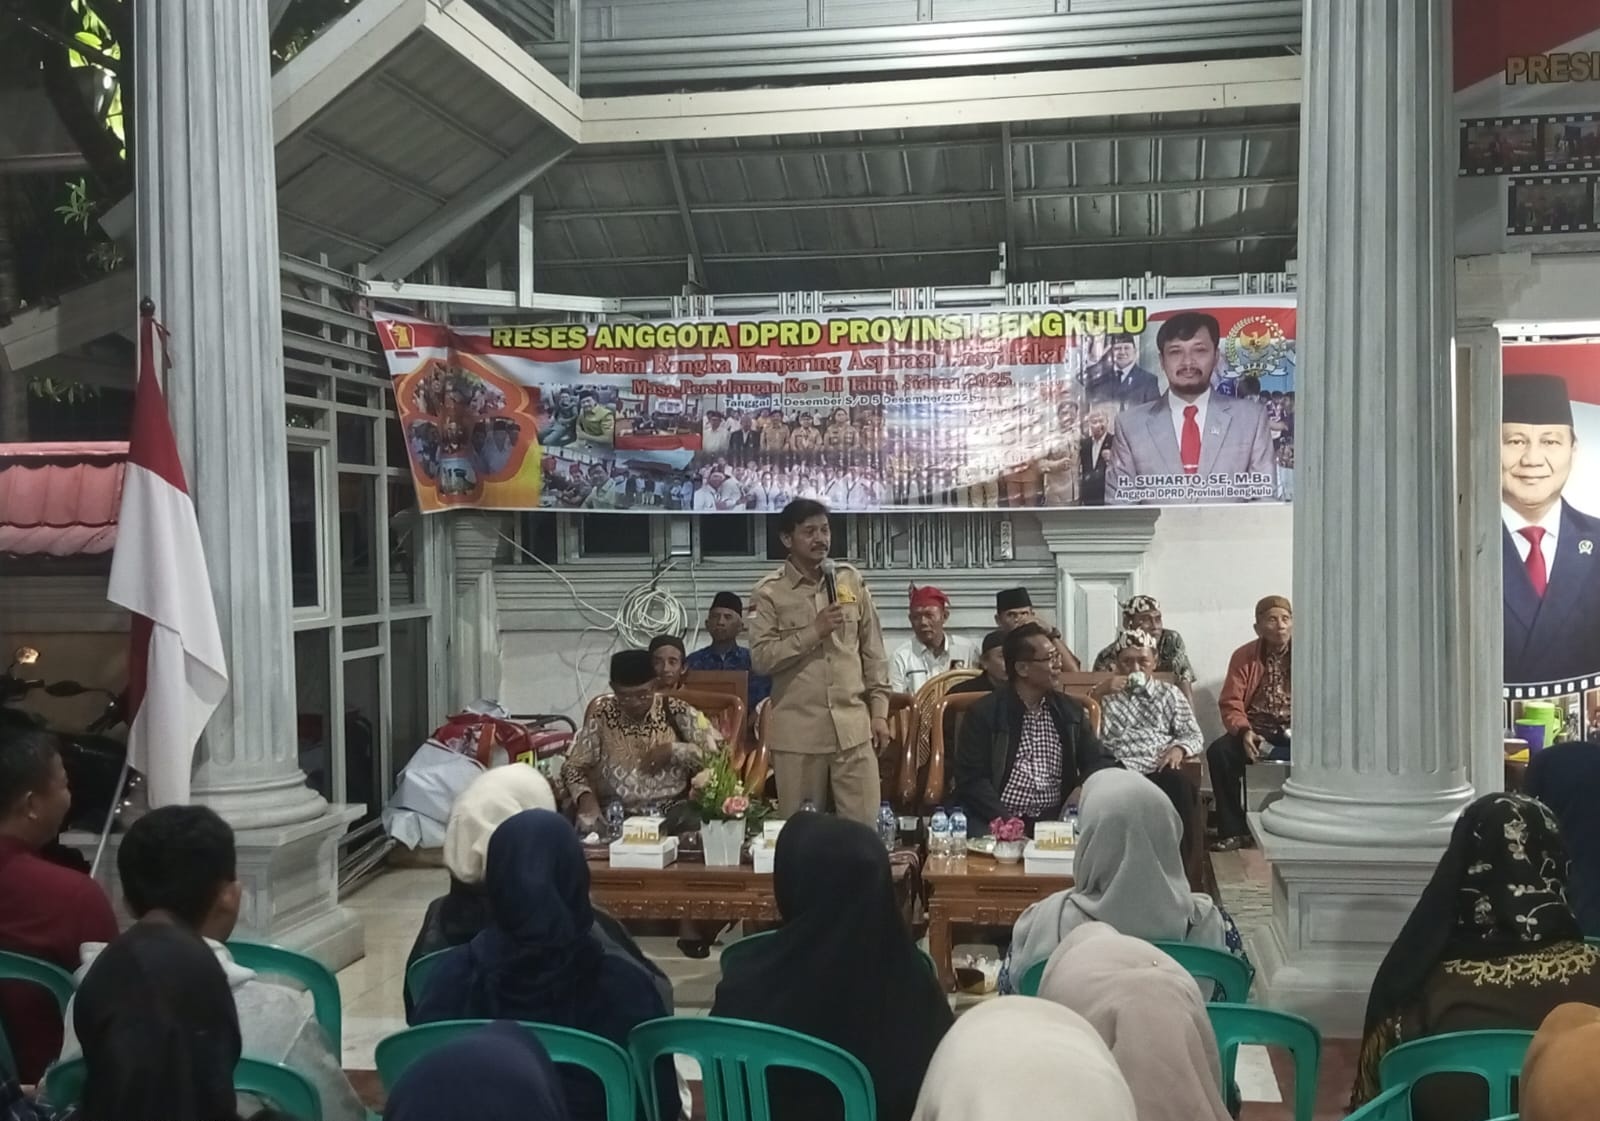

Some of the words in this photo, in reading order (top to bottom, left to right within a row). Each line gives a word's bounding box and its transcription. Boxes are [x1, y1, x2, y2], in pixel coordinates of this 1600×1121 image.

[491, 324, 588, 349] RESES
[593, 322, 733, 349] ANGGOTA
[738, 318, 822, 347] DPRD
[828, 312, 972, 345] PROVINSI
[977, 306, 1147, 340] BENGKULU
[580, 354, 648, 375] Dalam
[653, 353, 731, 377] Rangka
[737, 350, 842, 376] Menjaring
[848, 348, 937, 374] Aspirasi
[632, 379, 673, 395] Masa
[679, 377, 782, 396] Persidangan
[784, 377, 809, 394] Ke
[824, 377, 844, 393] III
[849, 374, 898, 393] Tahun
[963, 371, 1013, 391] 2025
[725, 398, 770, 410] Tanggal
[773, 398, 780, 407] 1
[783, 396, 842, 407] Desember
[845, 395, 869, 407] S/D
[871, 395, 880, 405] 5
[883, 394, 941, 405] Desember
[1119, 476, 1133, 487] H.
[1136, 474, 1206, 487] SUHARTO,
[1209, 473, 1232, 486] SE,
[1235, 473, 1272, 485] M.Ba
[1116, 488, 1155, 501] Anggota
[1157, 487, 1185, 499] DPRD
[1187, 486, 1225, 498] Provinsi
[1227, 485, 1273, 498] Bengkulu
